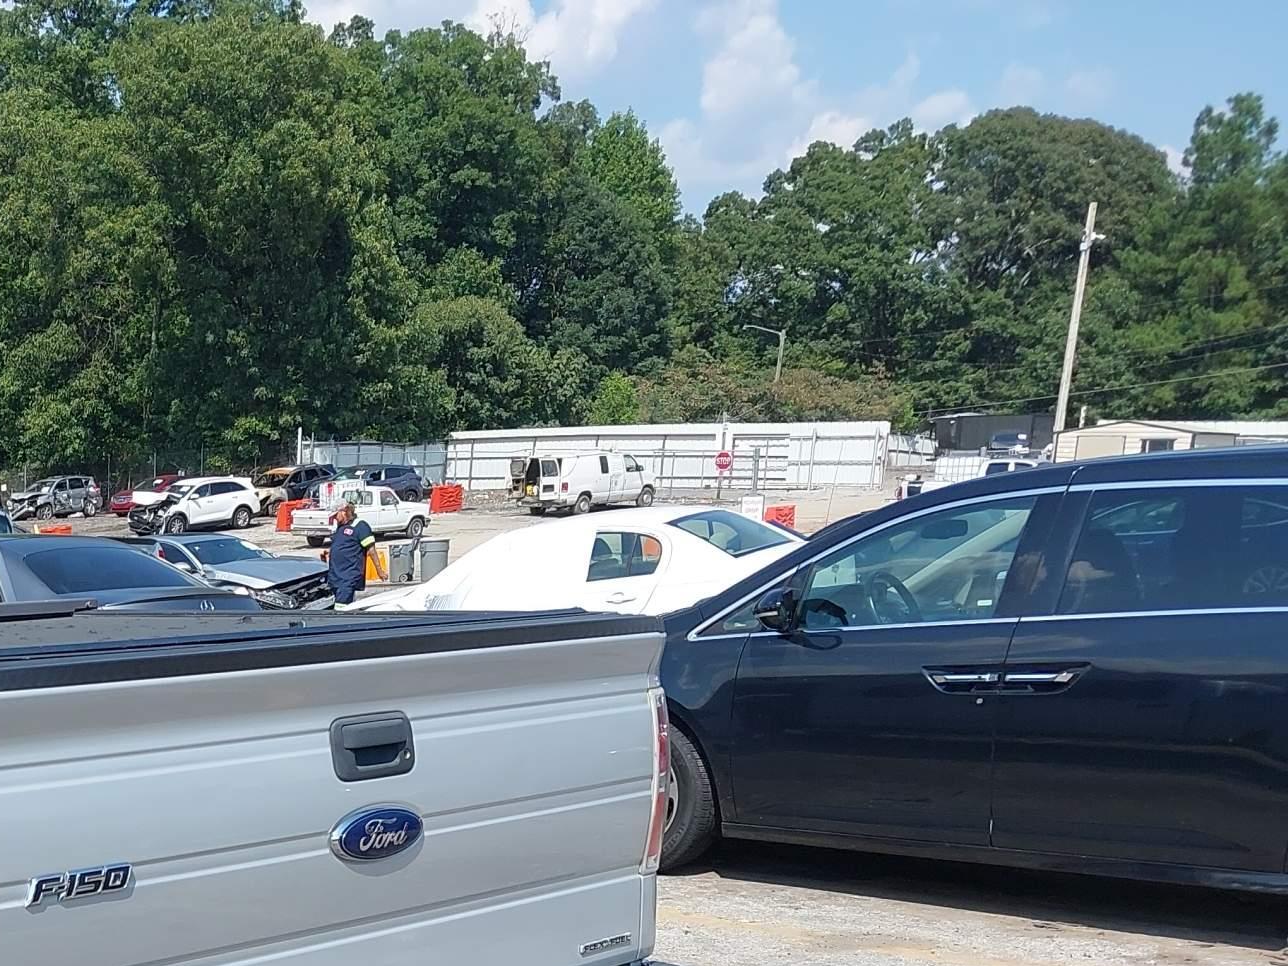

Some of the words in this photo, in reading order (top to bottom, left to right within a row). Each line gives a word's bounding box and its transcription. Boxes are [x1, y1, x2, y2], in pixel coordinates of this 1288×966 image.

[716, 457, 731, 465] STOP
[357, 817, 410, 852] Ford
[26, 863, 134, 909] F-150
